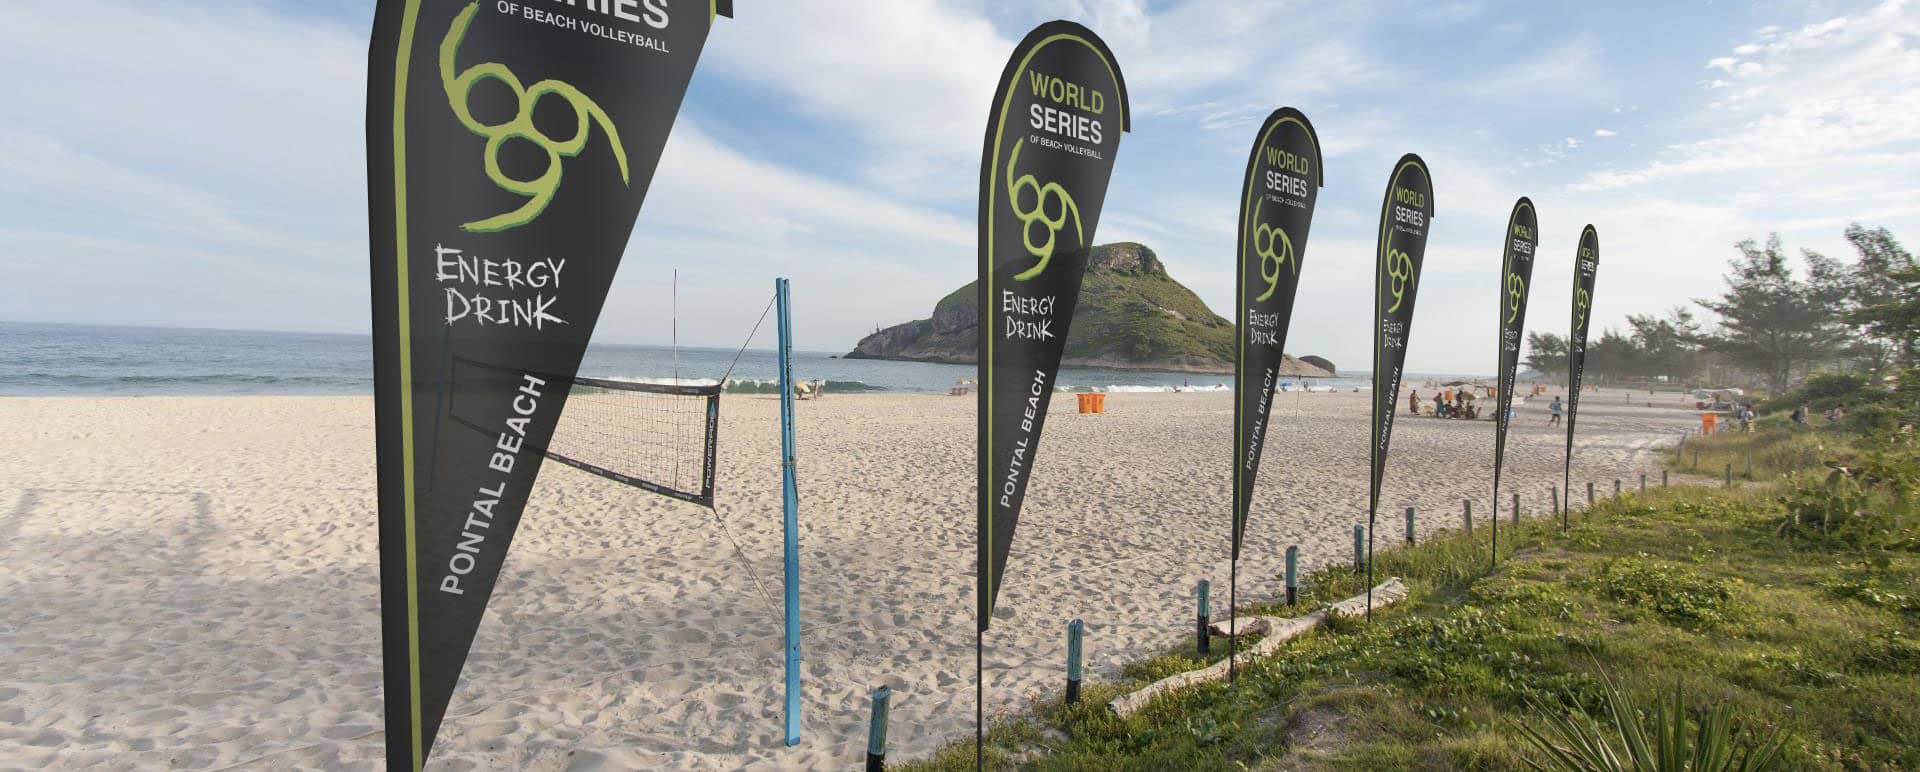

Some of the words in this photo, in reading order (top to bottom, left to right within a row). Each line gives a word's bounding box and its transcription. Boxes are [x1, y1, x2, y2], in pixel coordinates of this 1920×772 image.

[497, 0, 519, 16] OF
[523, 7, 577, 31] BEACH
[580, 20, 670, 54] VOLLEYBALL
[1029, 69, 1105, 115] WORLD
[1030, 103, 1103, 145] SERIES
[1266, 145, 1309, 176] WORLD
[1266, 170, 1308, 198] SERIES
[1395, 185, 1425, 209] WORLD
[1395, 205, 1424, 227] SERIES
[434, 242, 566, 290] ENERGY
[443, 287, 569, 331] DRINK
[1003, 288, 1056, 317] ENERGY
[1006, 315, 1056, 342] DRINK
[1000, 437, 1029, 508] PONTAL
[1021, 368, 1047, 434] BEACH
[1246, 420, 1263, 471] PONTAL
[1258, 367, 1274, 416] BEACH
[439, 482, 506, 596] PONTAL
[489, 373, 547, 475] BEACH
